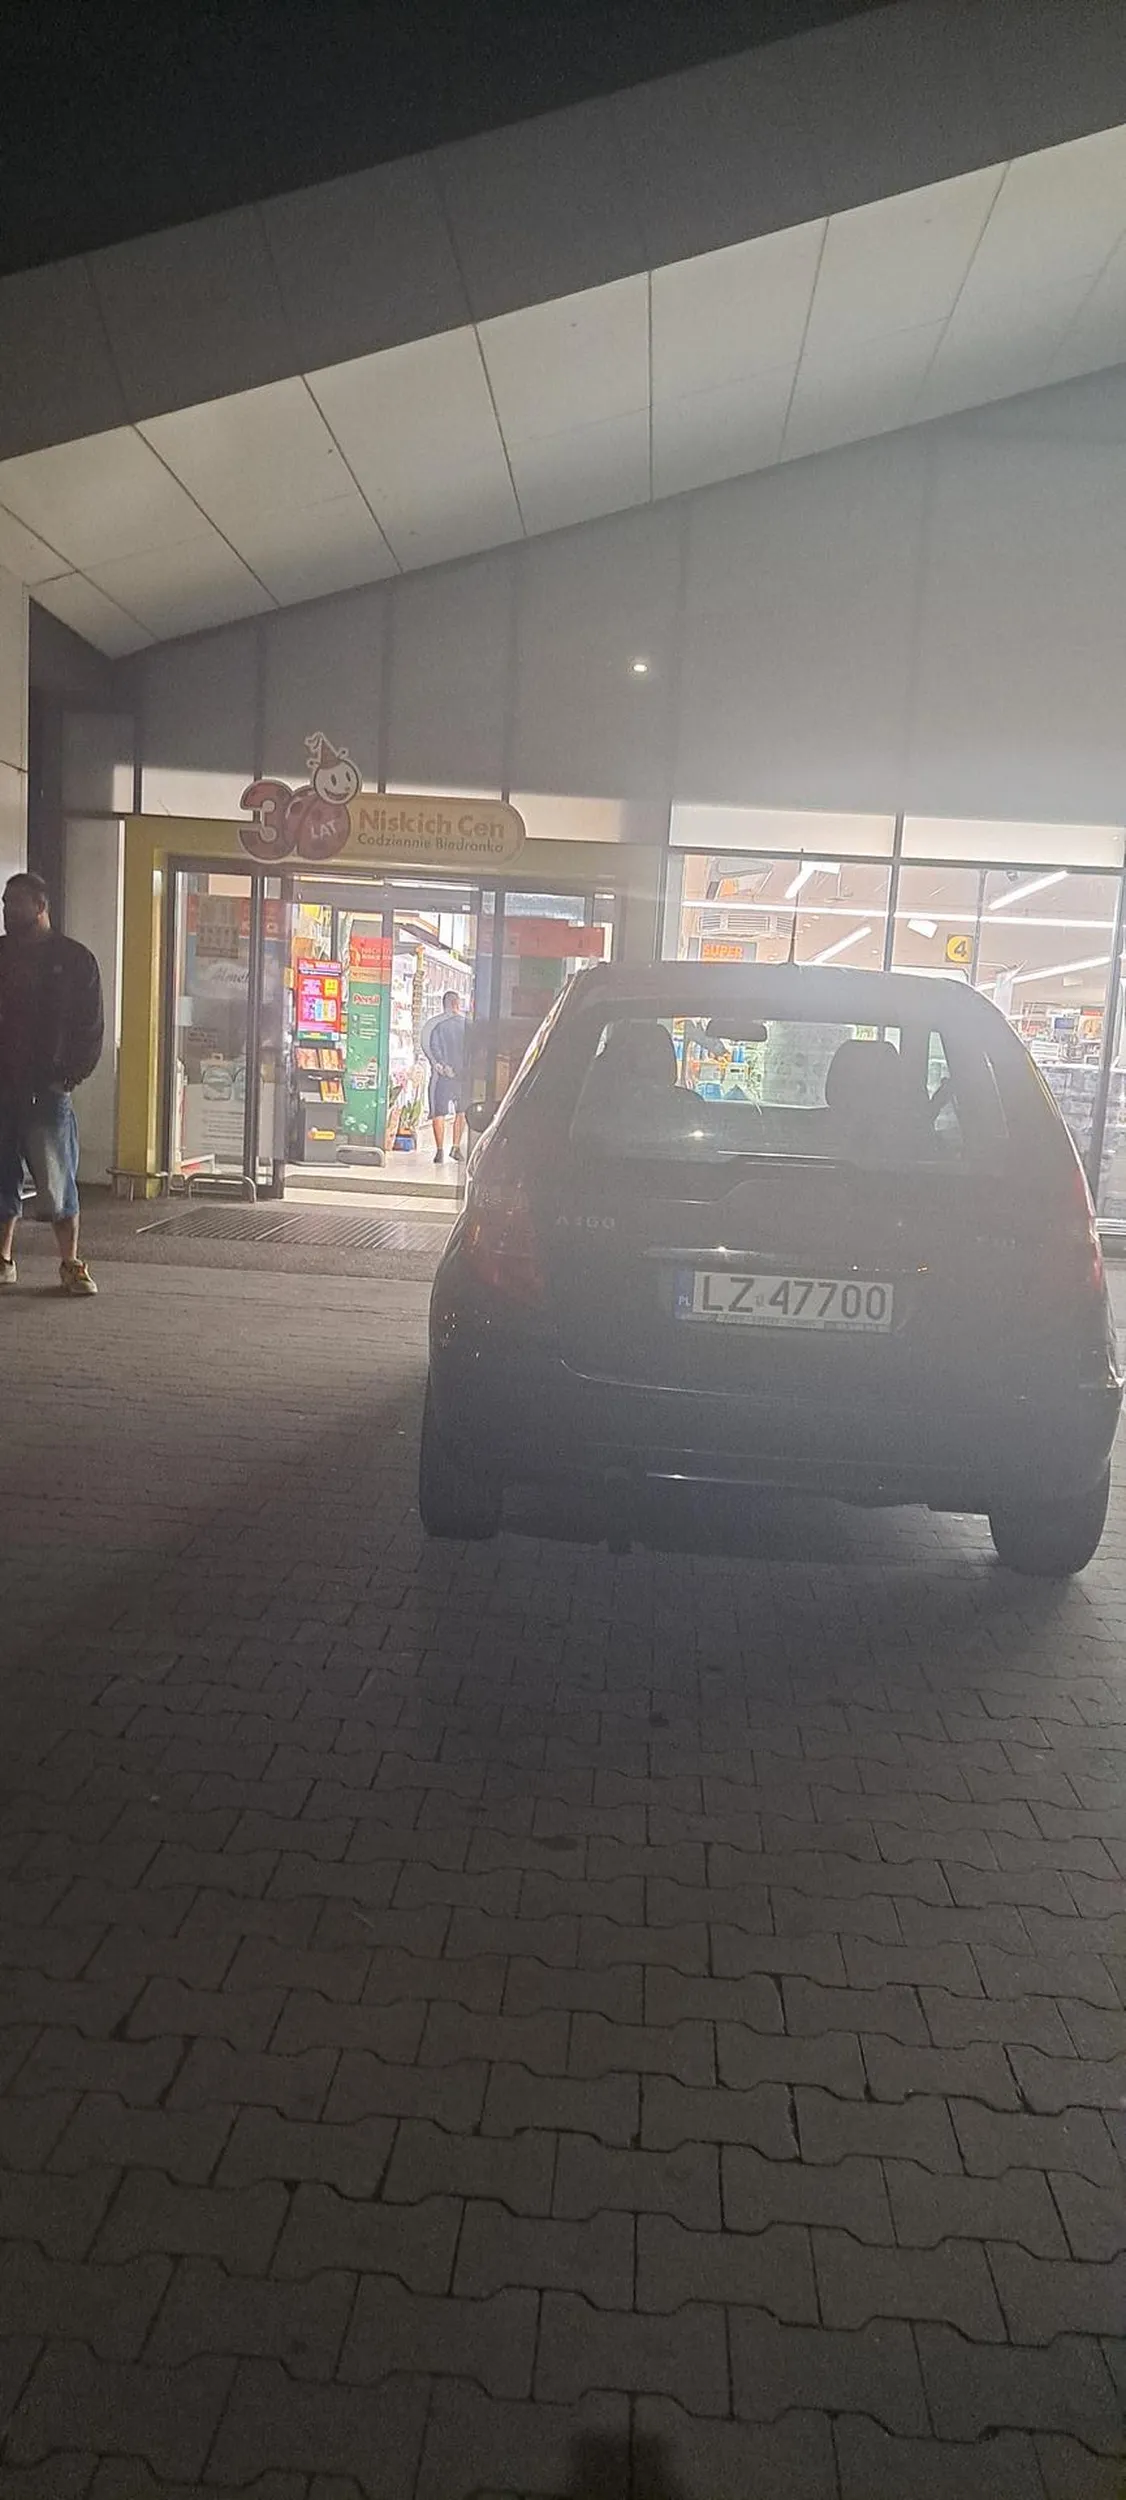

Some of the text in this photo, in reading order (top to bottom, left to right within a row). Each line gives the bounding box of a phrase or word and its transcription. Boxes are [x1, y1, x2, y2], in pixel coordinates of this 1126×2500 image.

[310, 820, 338, 839] LAT
[358, 808, 505, 838] Niskich Cen
[357, 832, 504, 853] Codziennie Biedronka
[702, 943, 743, 959] SUPER
[953, 939, 968, 958] 4
[677, 1295, 691, 1307] PL
[702, 1275, 887, 1320] LZ 47700
